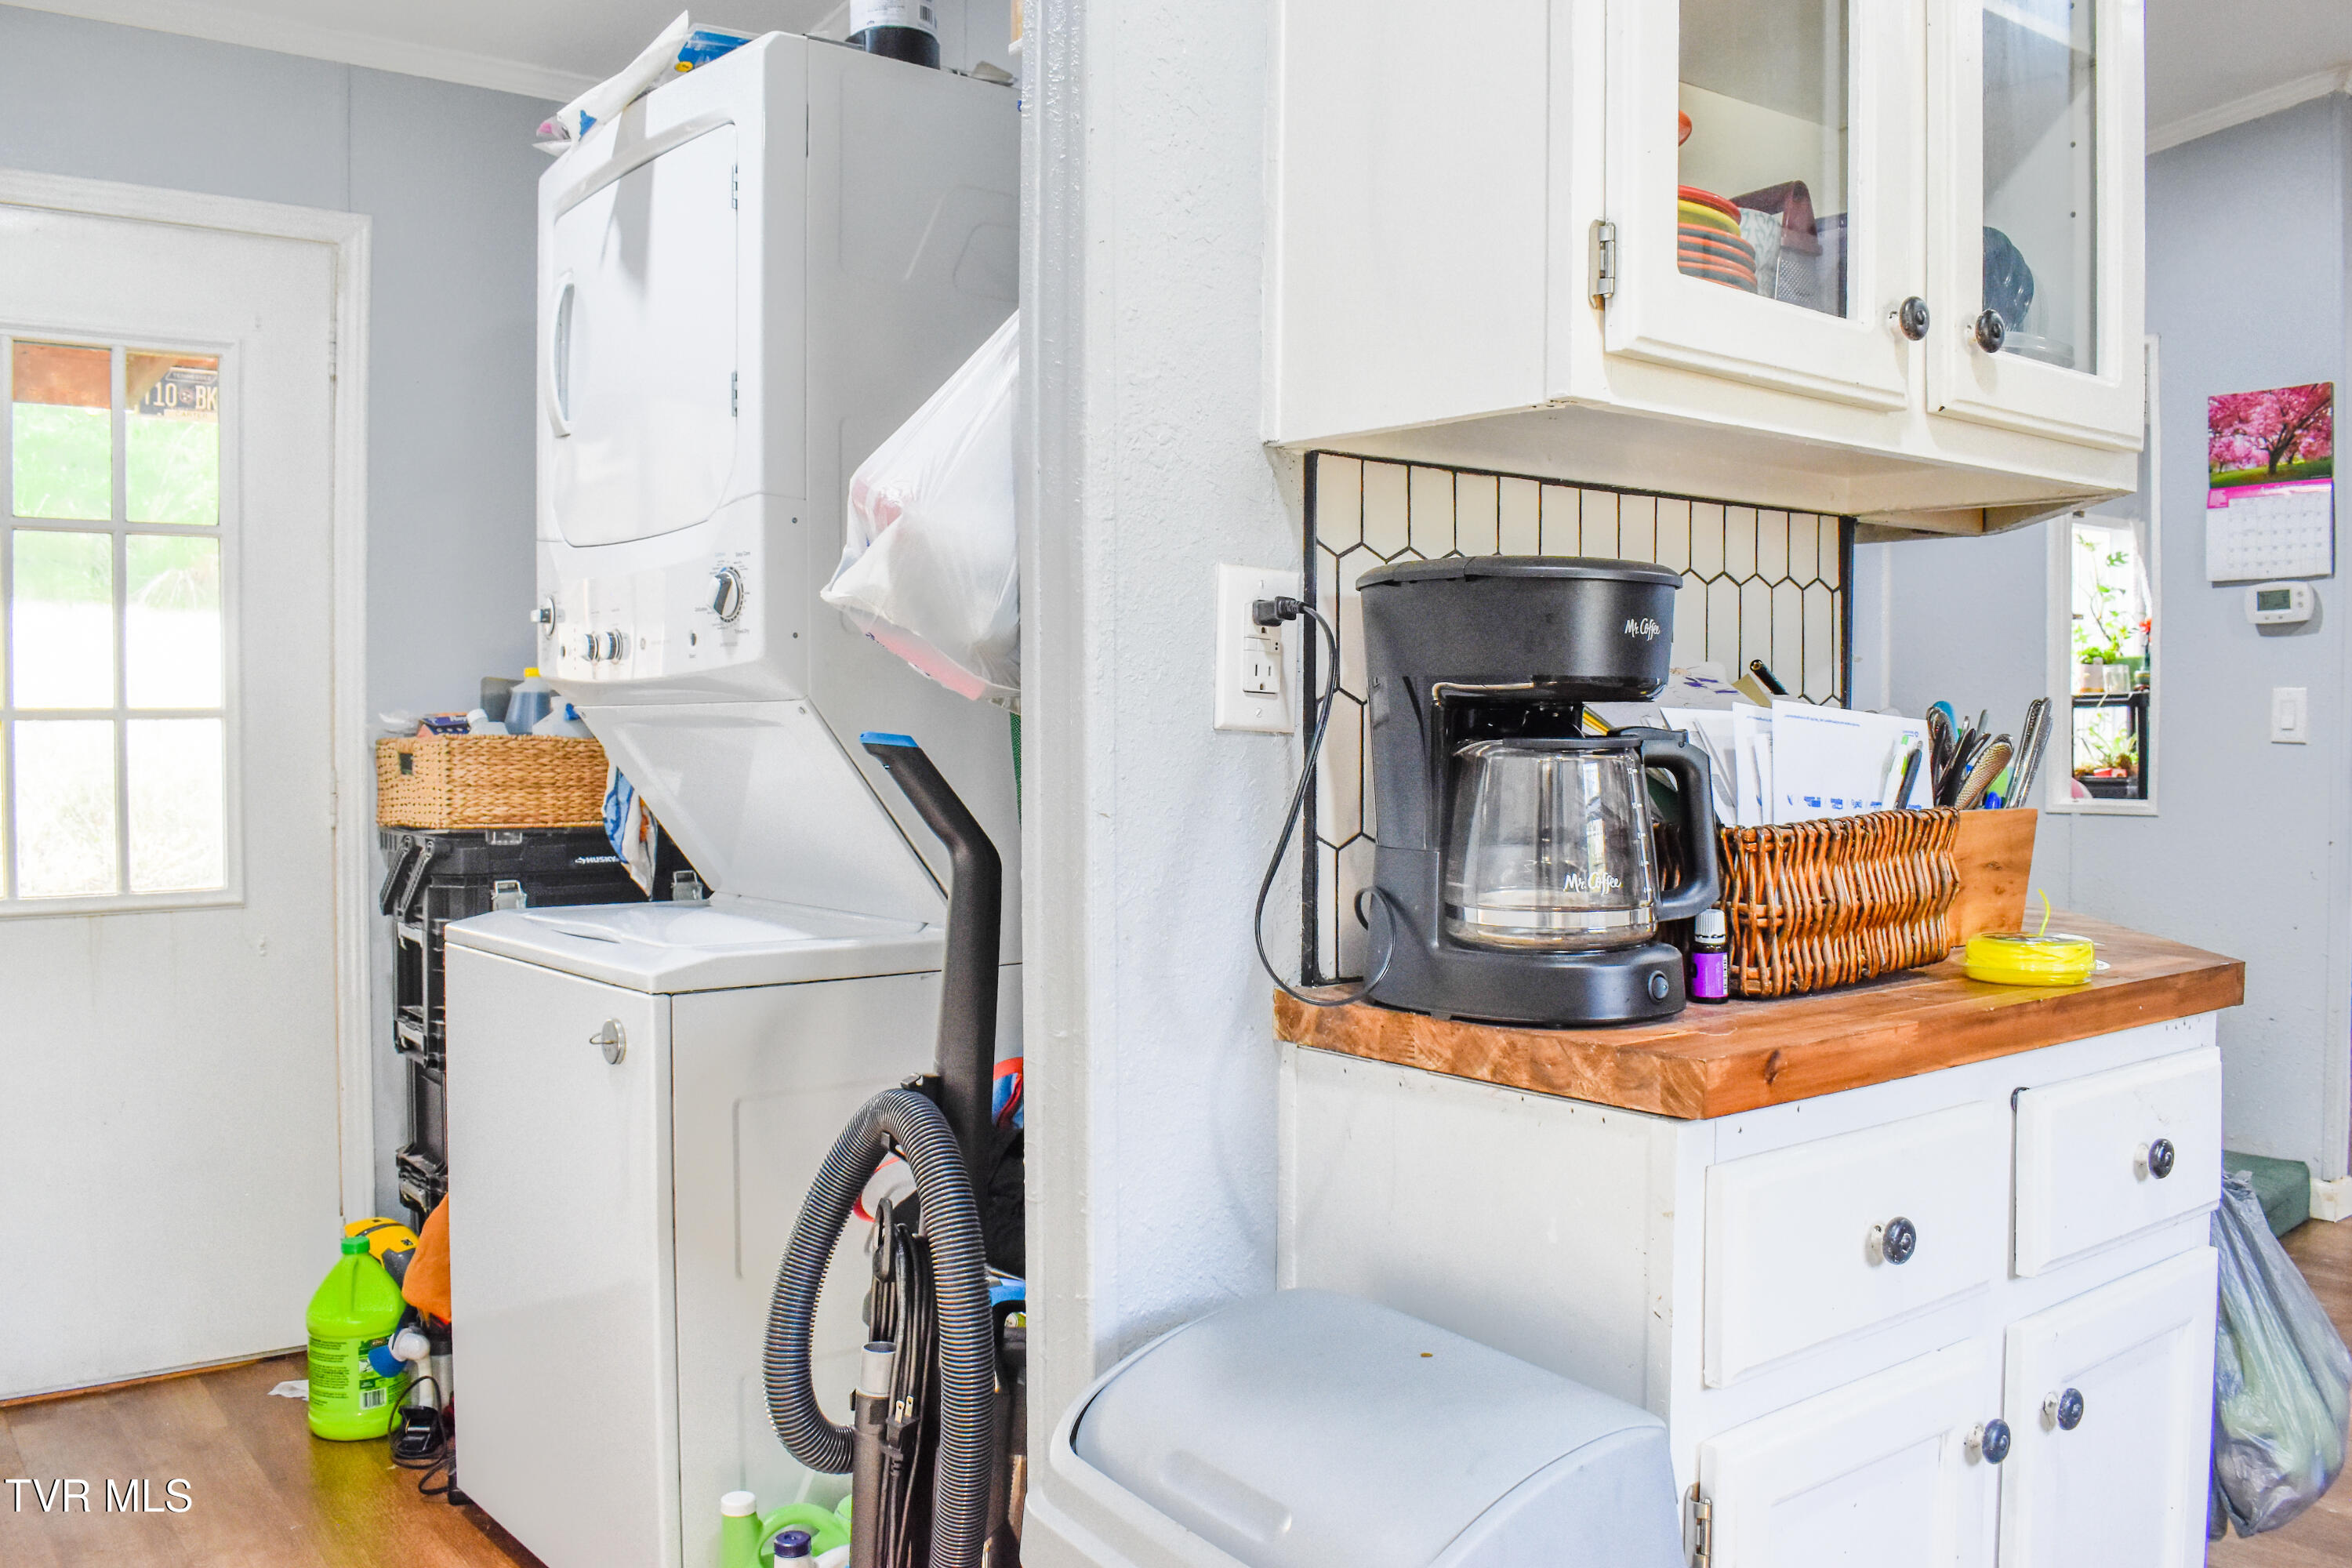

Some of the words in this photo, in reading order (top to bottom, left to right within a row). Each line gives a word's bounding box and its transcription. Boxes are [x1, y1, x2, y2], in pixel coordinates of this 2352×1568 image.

[1624, 619, 1639, 637] Mr.
[1640, 618, 1661, 641] Coffee
[1563, 873, 1586, 893] Mr.
[1588, 871, 1622, 897] Coffee
